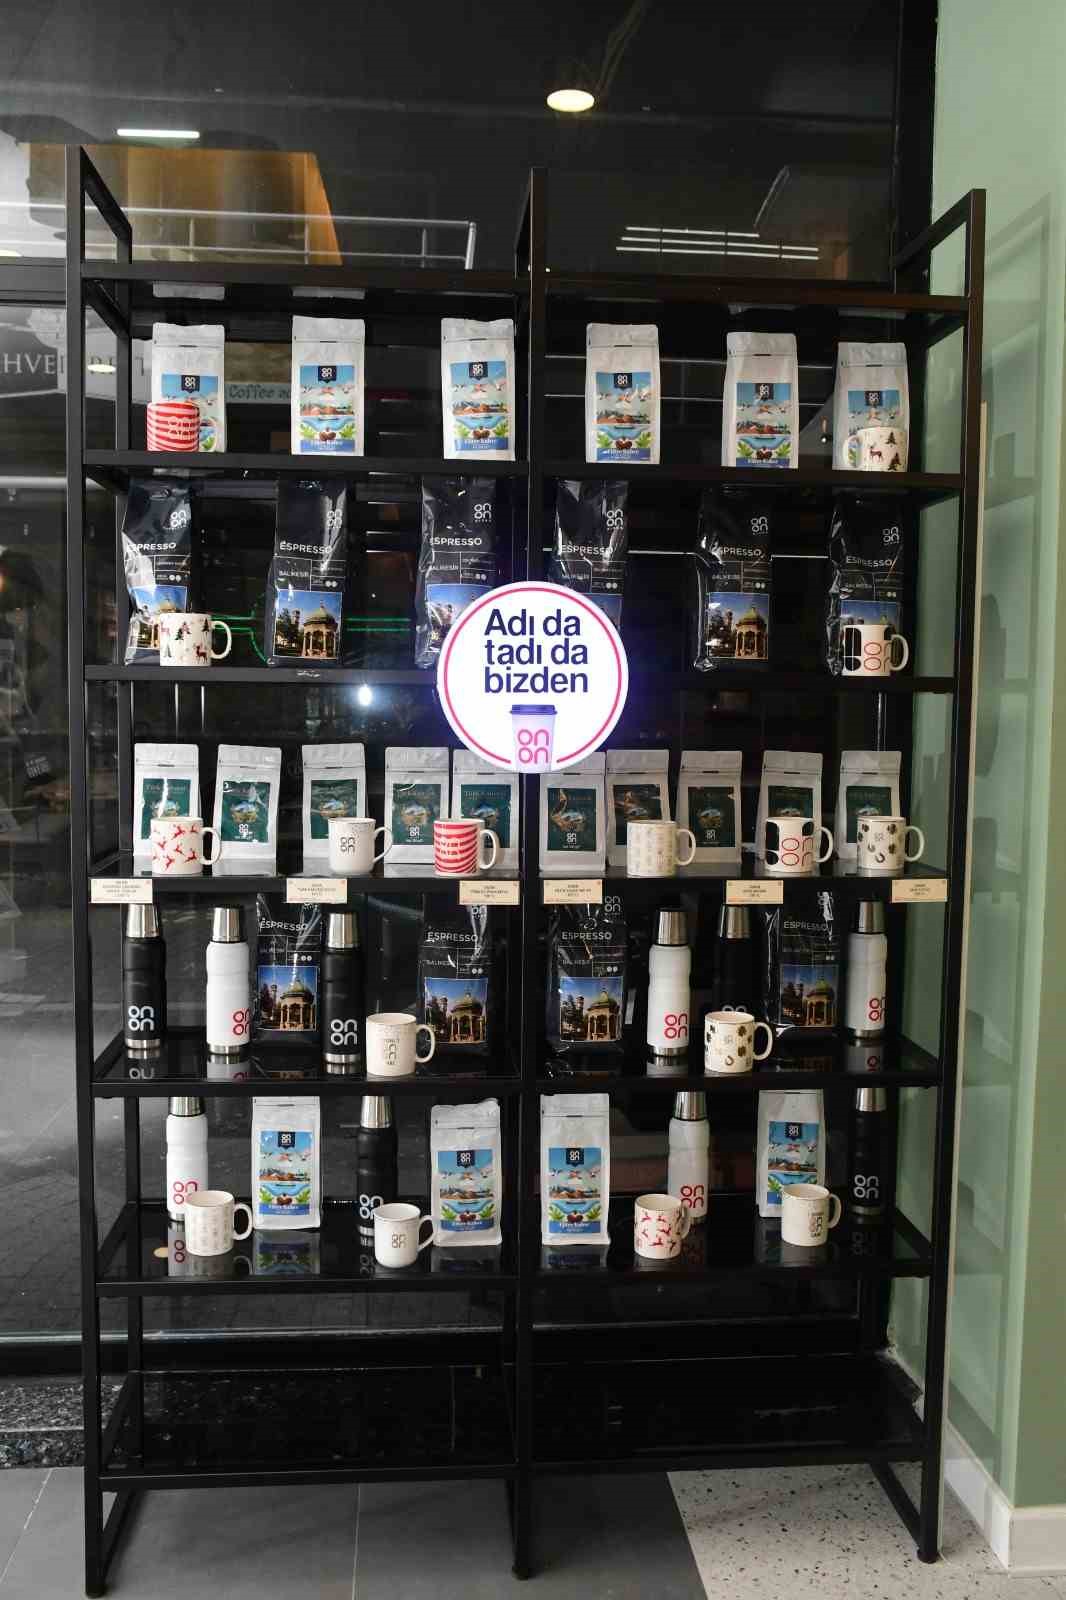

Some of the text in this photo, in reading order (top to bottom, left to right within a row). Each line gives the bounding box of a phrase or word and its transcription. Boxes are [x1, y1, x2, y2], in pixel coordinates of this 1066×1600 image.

[484, 608, 581, 636] Adı da
[485, 638, 588, 665] tadı da
[485, 666, 589, 693] bizden
[427, 931, 478, 943] ESPRESSO
[562, 932, 612, 940] ESPRESSO
